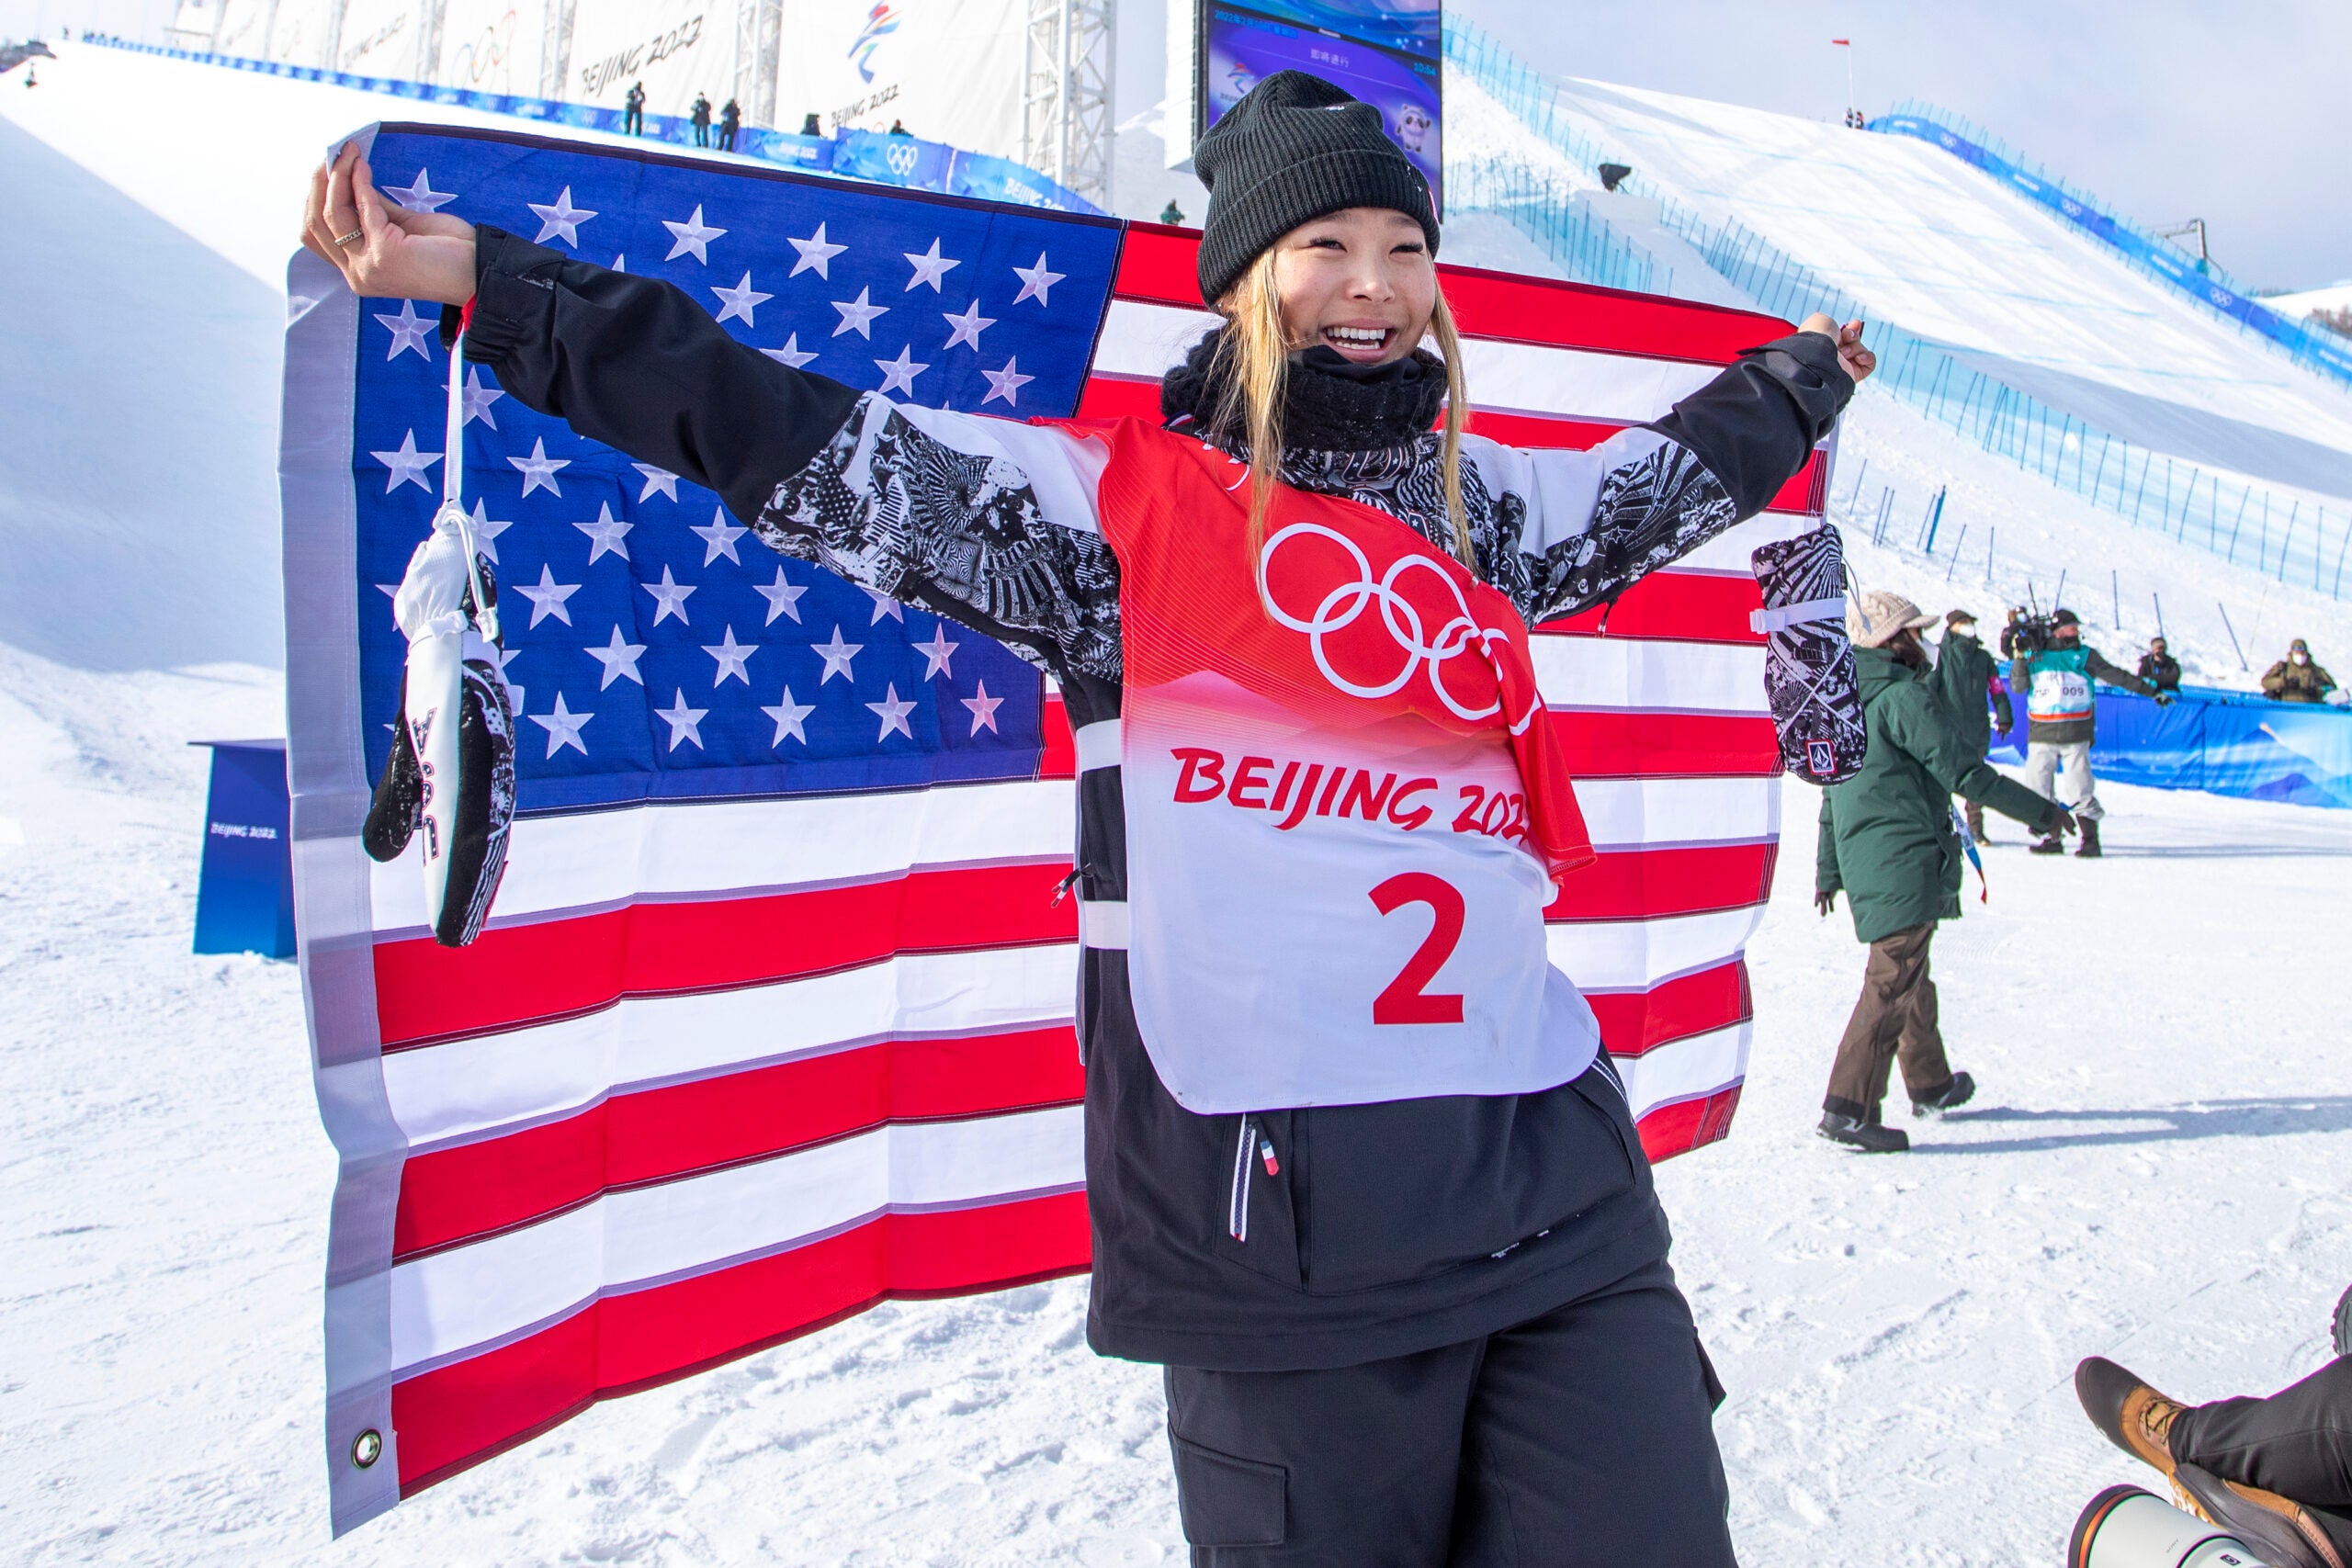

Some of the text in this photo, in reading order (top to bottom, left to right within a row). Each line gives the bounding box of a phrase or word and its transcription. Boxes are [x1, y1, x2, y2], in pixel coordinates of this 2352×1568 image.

[582, 15, 703, 97] BEIJING 2022
[831, 85, 899, 128] BEIJING 2022
[2062, 686, 2085, 697] 009
[1170, 747, 1529, 845] BEIJING 202
[210, 821, 277, 840] BEIJING 2022
[1368, 872, 1465, 1025] 2
